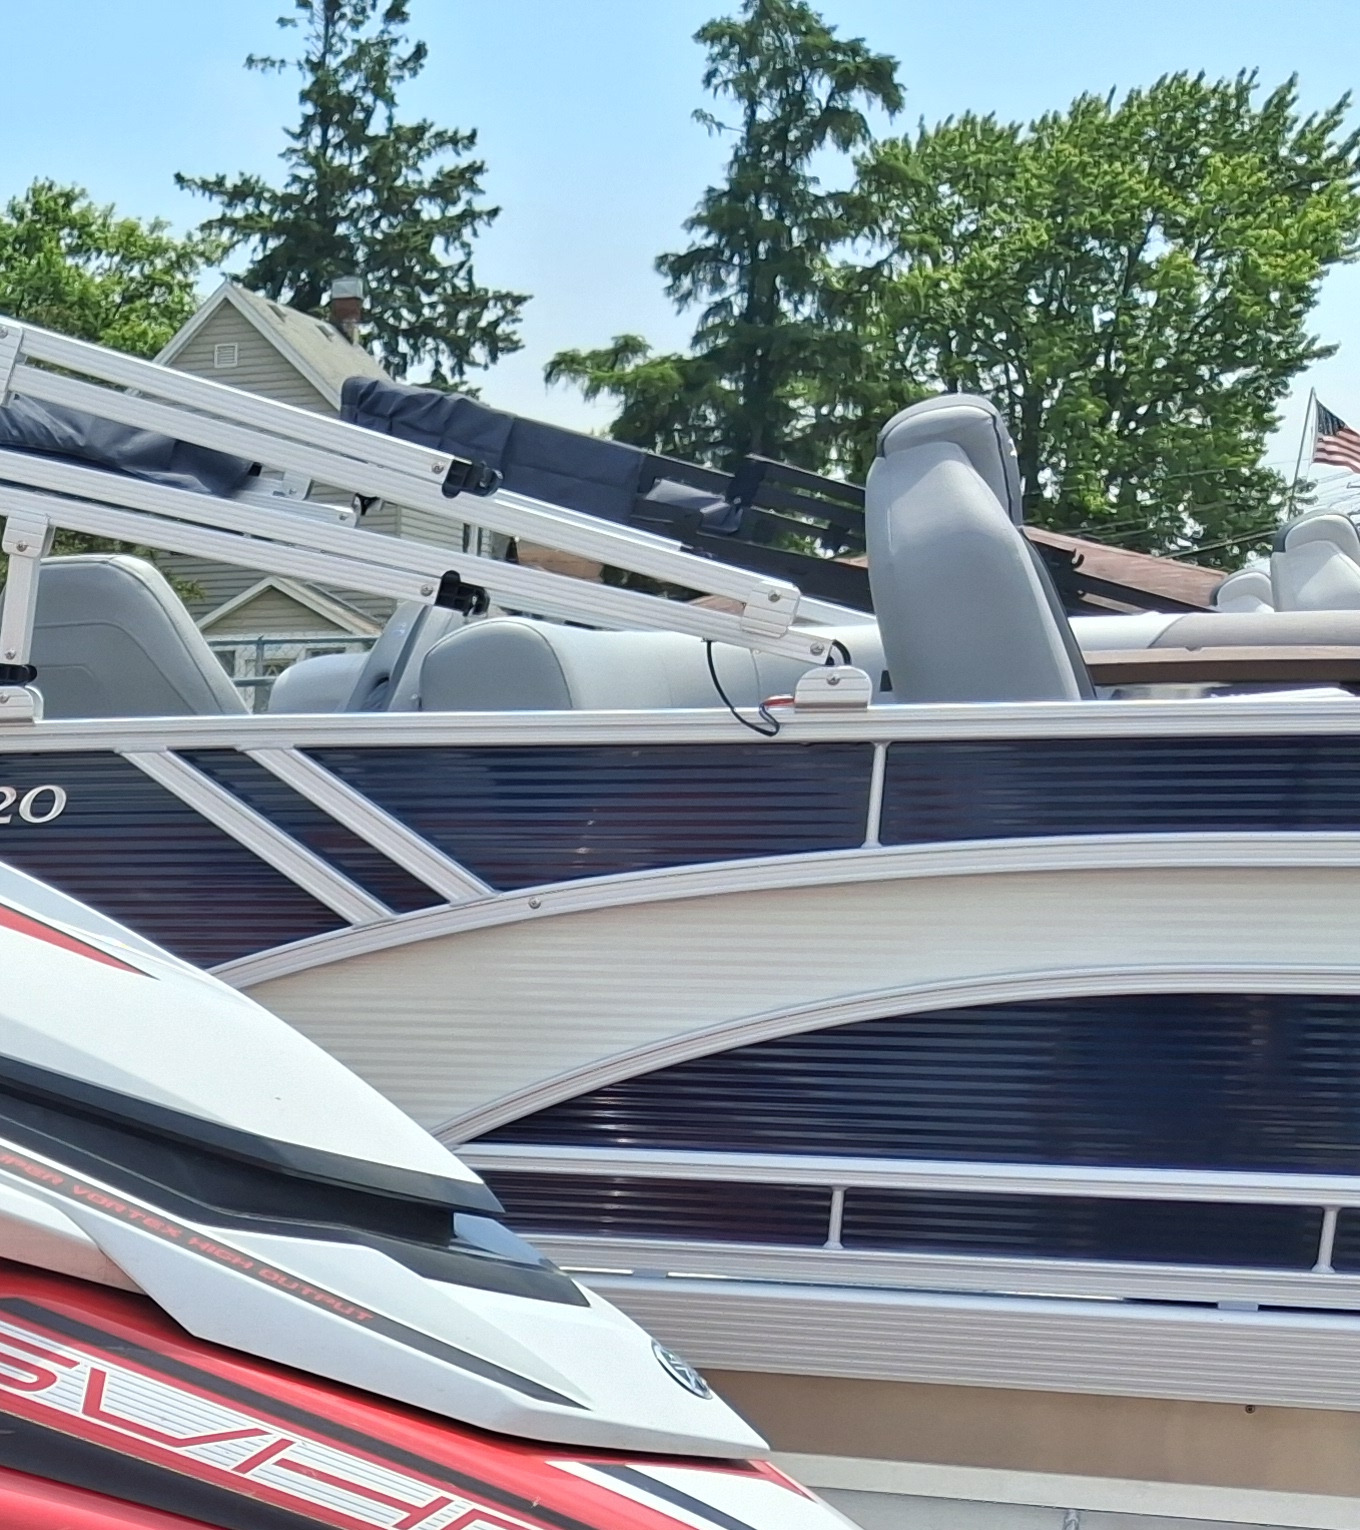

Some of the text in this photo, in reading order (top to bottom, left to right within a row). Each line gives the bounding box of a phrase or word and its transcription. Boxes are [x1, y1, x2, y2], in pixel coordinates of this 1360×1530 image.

[73, 1184, 181, 1239] VORTEX
[188, 1236, 254, 1270] HIGH
[258, 1268, 374, 1323] OUTPUT
